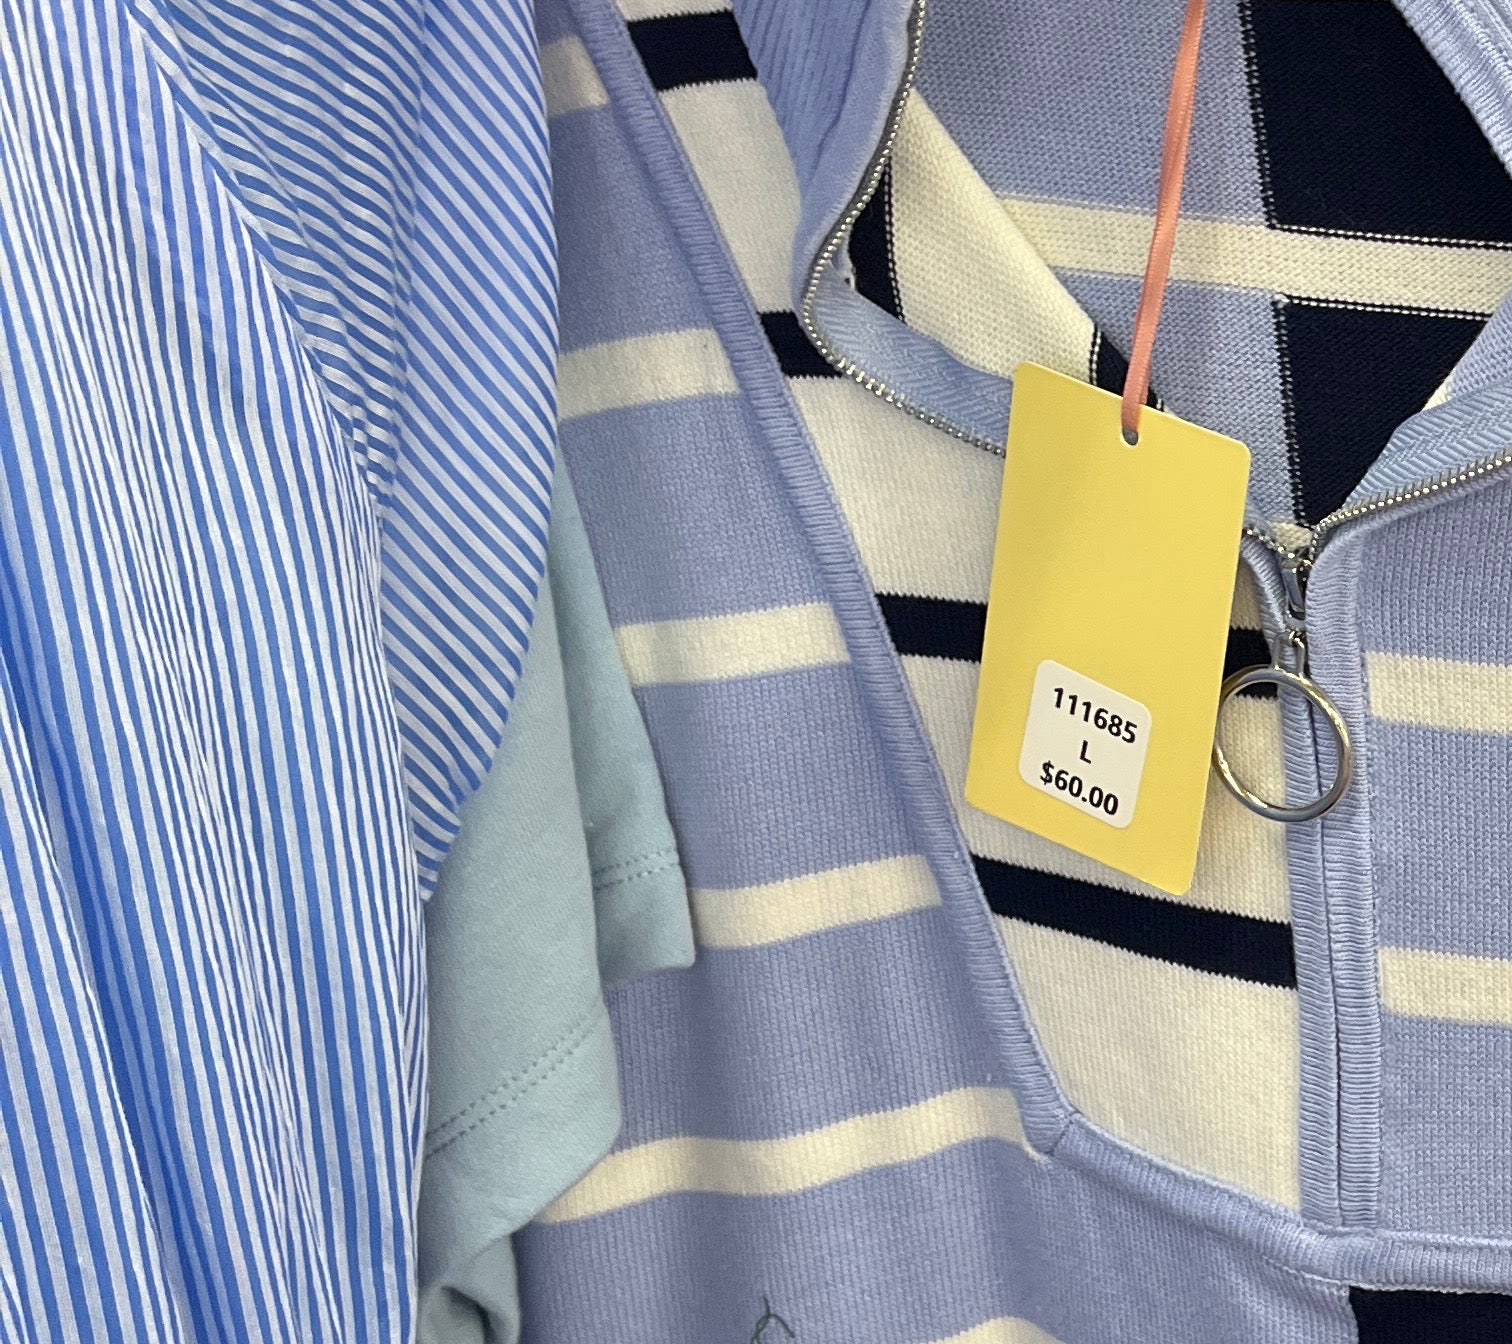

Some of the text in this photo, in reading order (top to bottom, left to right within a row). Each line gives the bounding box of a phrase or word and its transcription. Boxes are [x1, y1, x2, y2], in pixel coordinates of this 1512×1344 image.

[1054, 687, 1138, 744] 111685
[1079, 740, 1092, 764] L
[1040, 760, 1119, 816] $60.00
